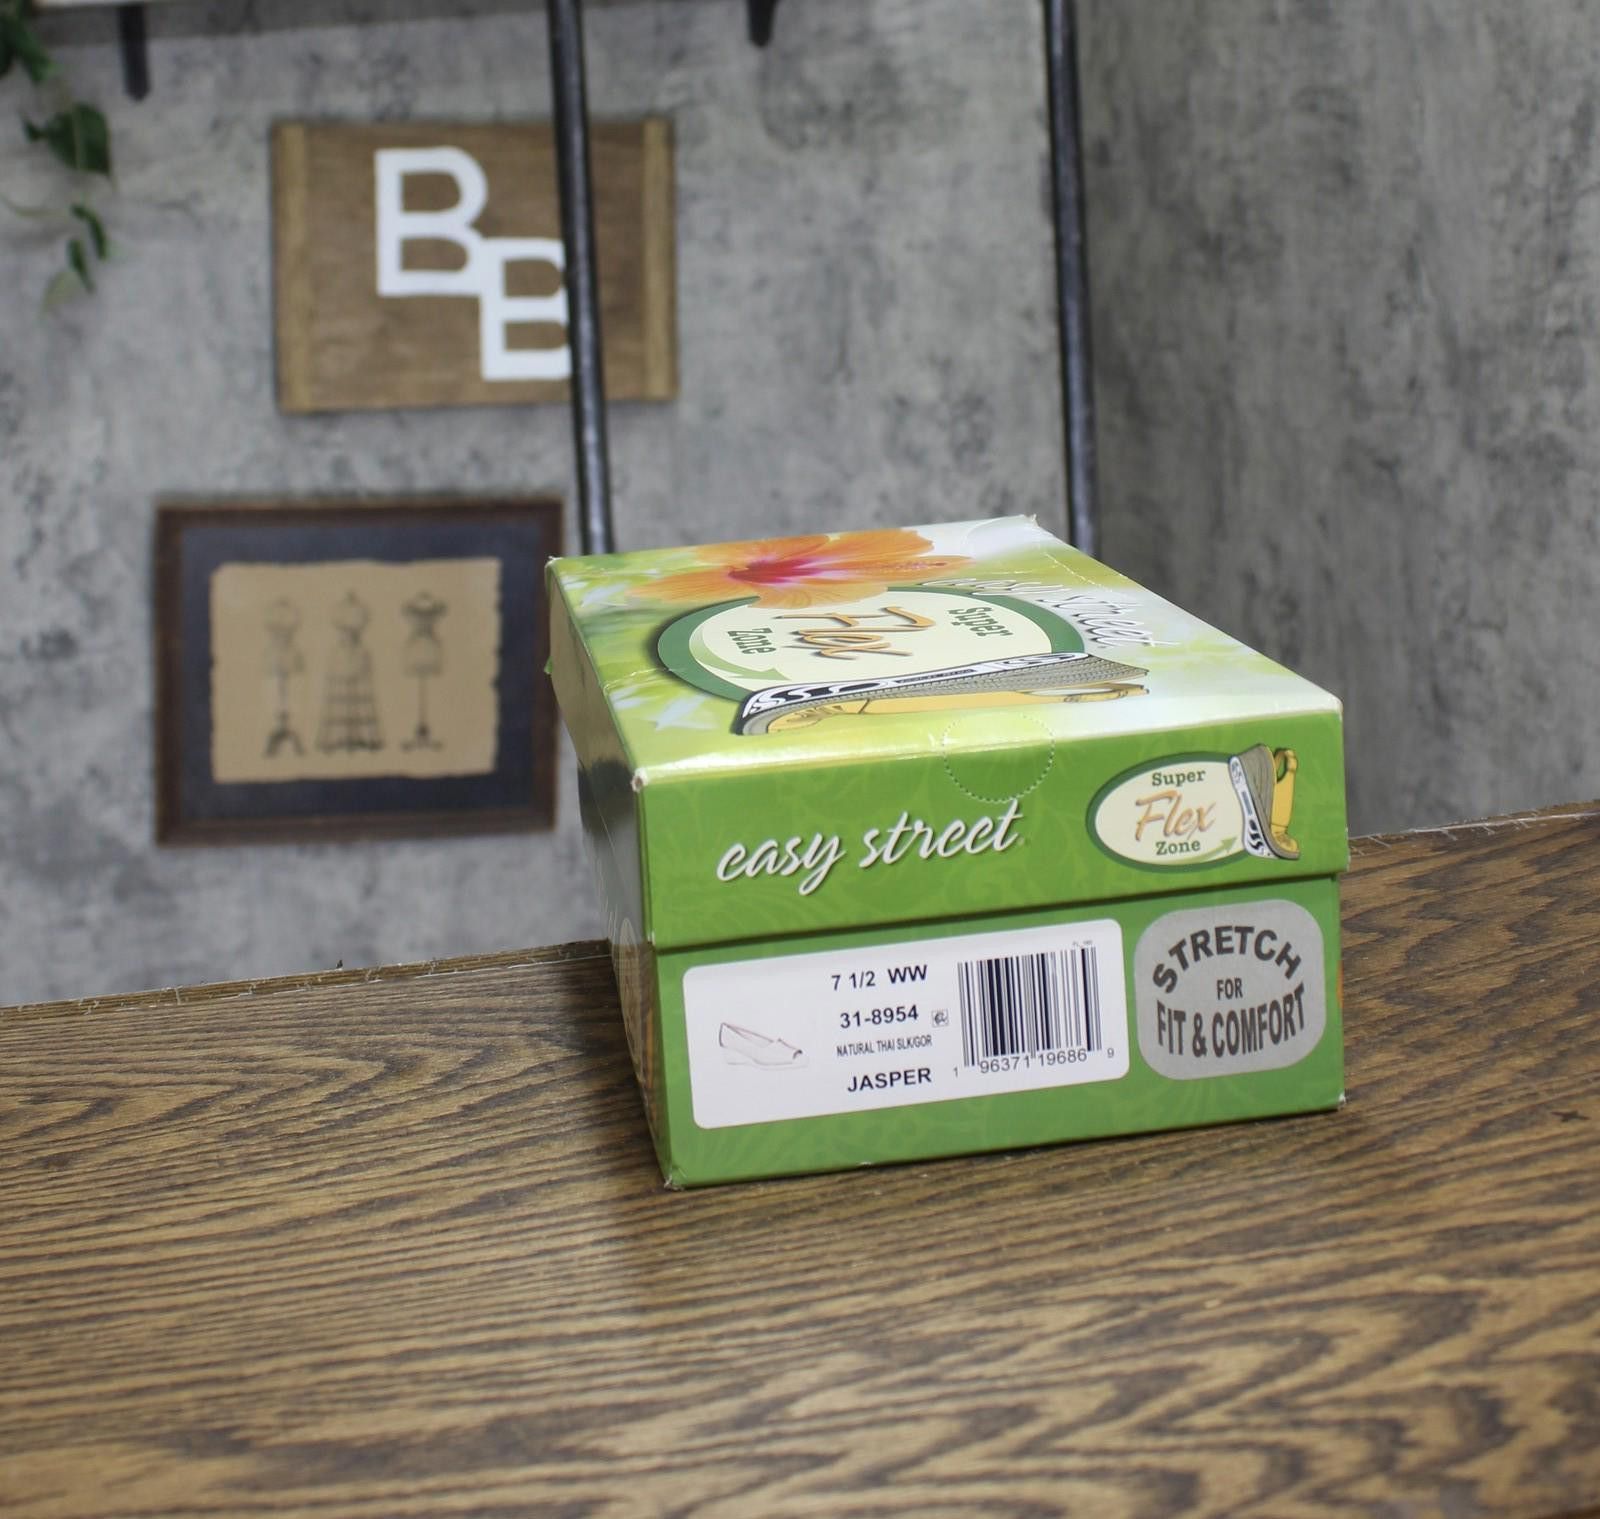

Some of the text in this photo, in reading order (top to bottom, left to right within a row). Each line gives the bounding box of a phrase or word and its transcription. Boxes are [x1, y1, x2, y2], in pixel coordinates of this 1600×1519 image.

[774, 606, 936, 660] Flex
[948, 606, 1013, 637] Super
[727, 628, 777, 655] Zone
[1151, 769, 1206, 787] Super
[1134, 790, 1217, 842] Flex
[716, 798, 1024, 896] easy street
[1155, 839, 1200, 856] Zone
[1152, 924, 1302, 994] STRETCH
[831, 964, 928, 991] 7 1/2 WW
[1216, 977, 1243, 1001] FOR
[840, 1004, 919, 1029] 31-8954
[1156, 983, 1306, 1059] FIT & COMFORT
[836, 1043, 875, 1057] NATURAL
[877, 1039, 896, 1051] THAI
[847, 1067, 932, 1093] JASPER
